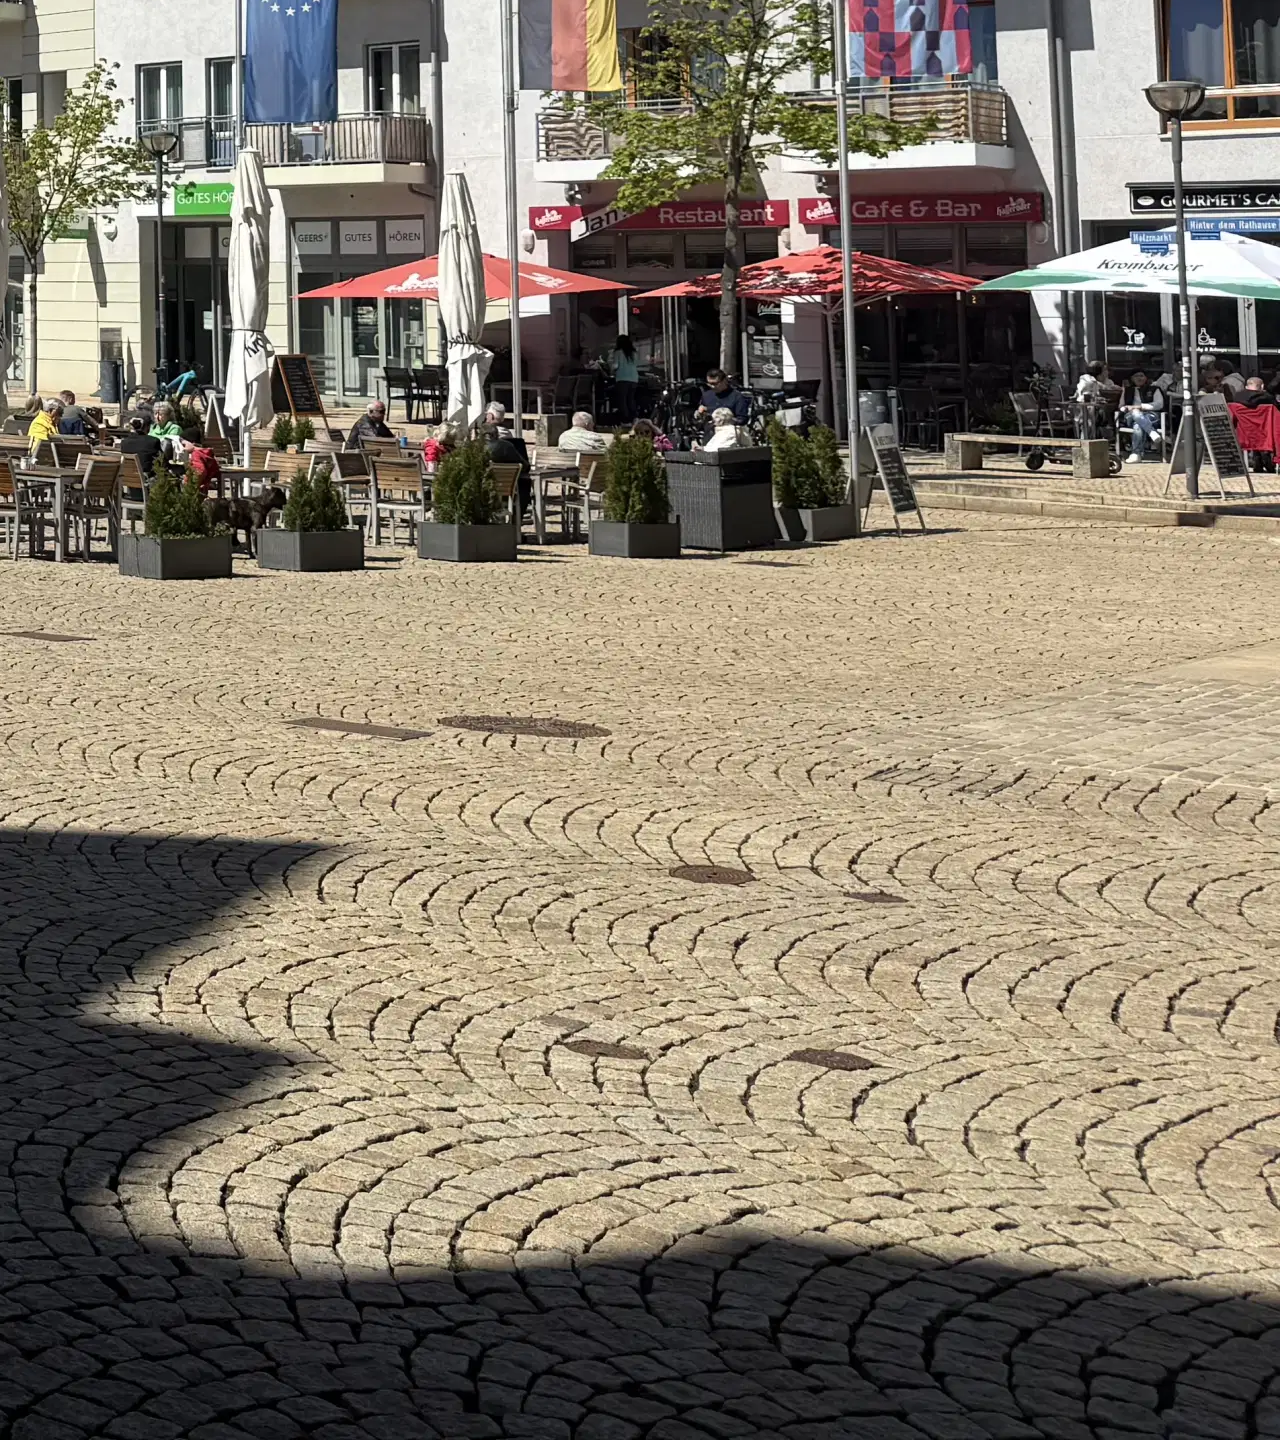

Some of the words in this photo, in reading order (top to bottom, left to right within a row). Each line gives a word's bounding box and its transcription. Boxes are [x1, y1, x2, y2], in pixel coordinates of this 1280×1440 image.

[176, 192, 211, 205] GUTES
[1255, 193, 1280, 206] CA
[658, 204, 775, 224] Restauant
[851, 200, 904, 219] Cafe
[909, 200, 928, 217] &
[934, 200, 981, 218] Bar
[1189, 220, 1215, 230] Hinter
[1218, 220, 1236, 230] dem
[1238, 218, 1277, 230] Rathause
[297, 233, 324, 243] GEERS
[344, 232, 372, 242] GUTES
[388, 230, 421, 242] HÖREN
[1132, 233, 1173, 243] Holzmarkt
